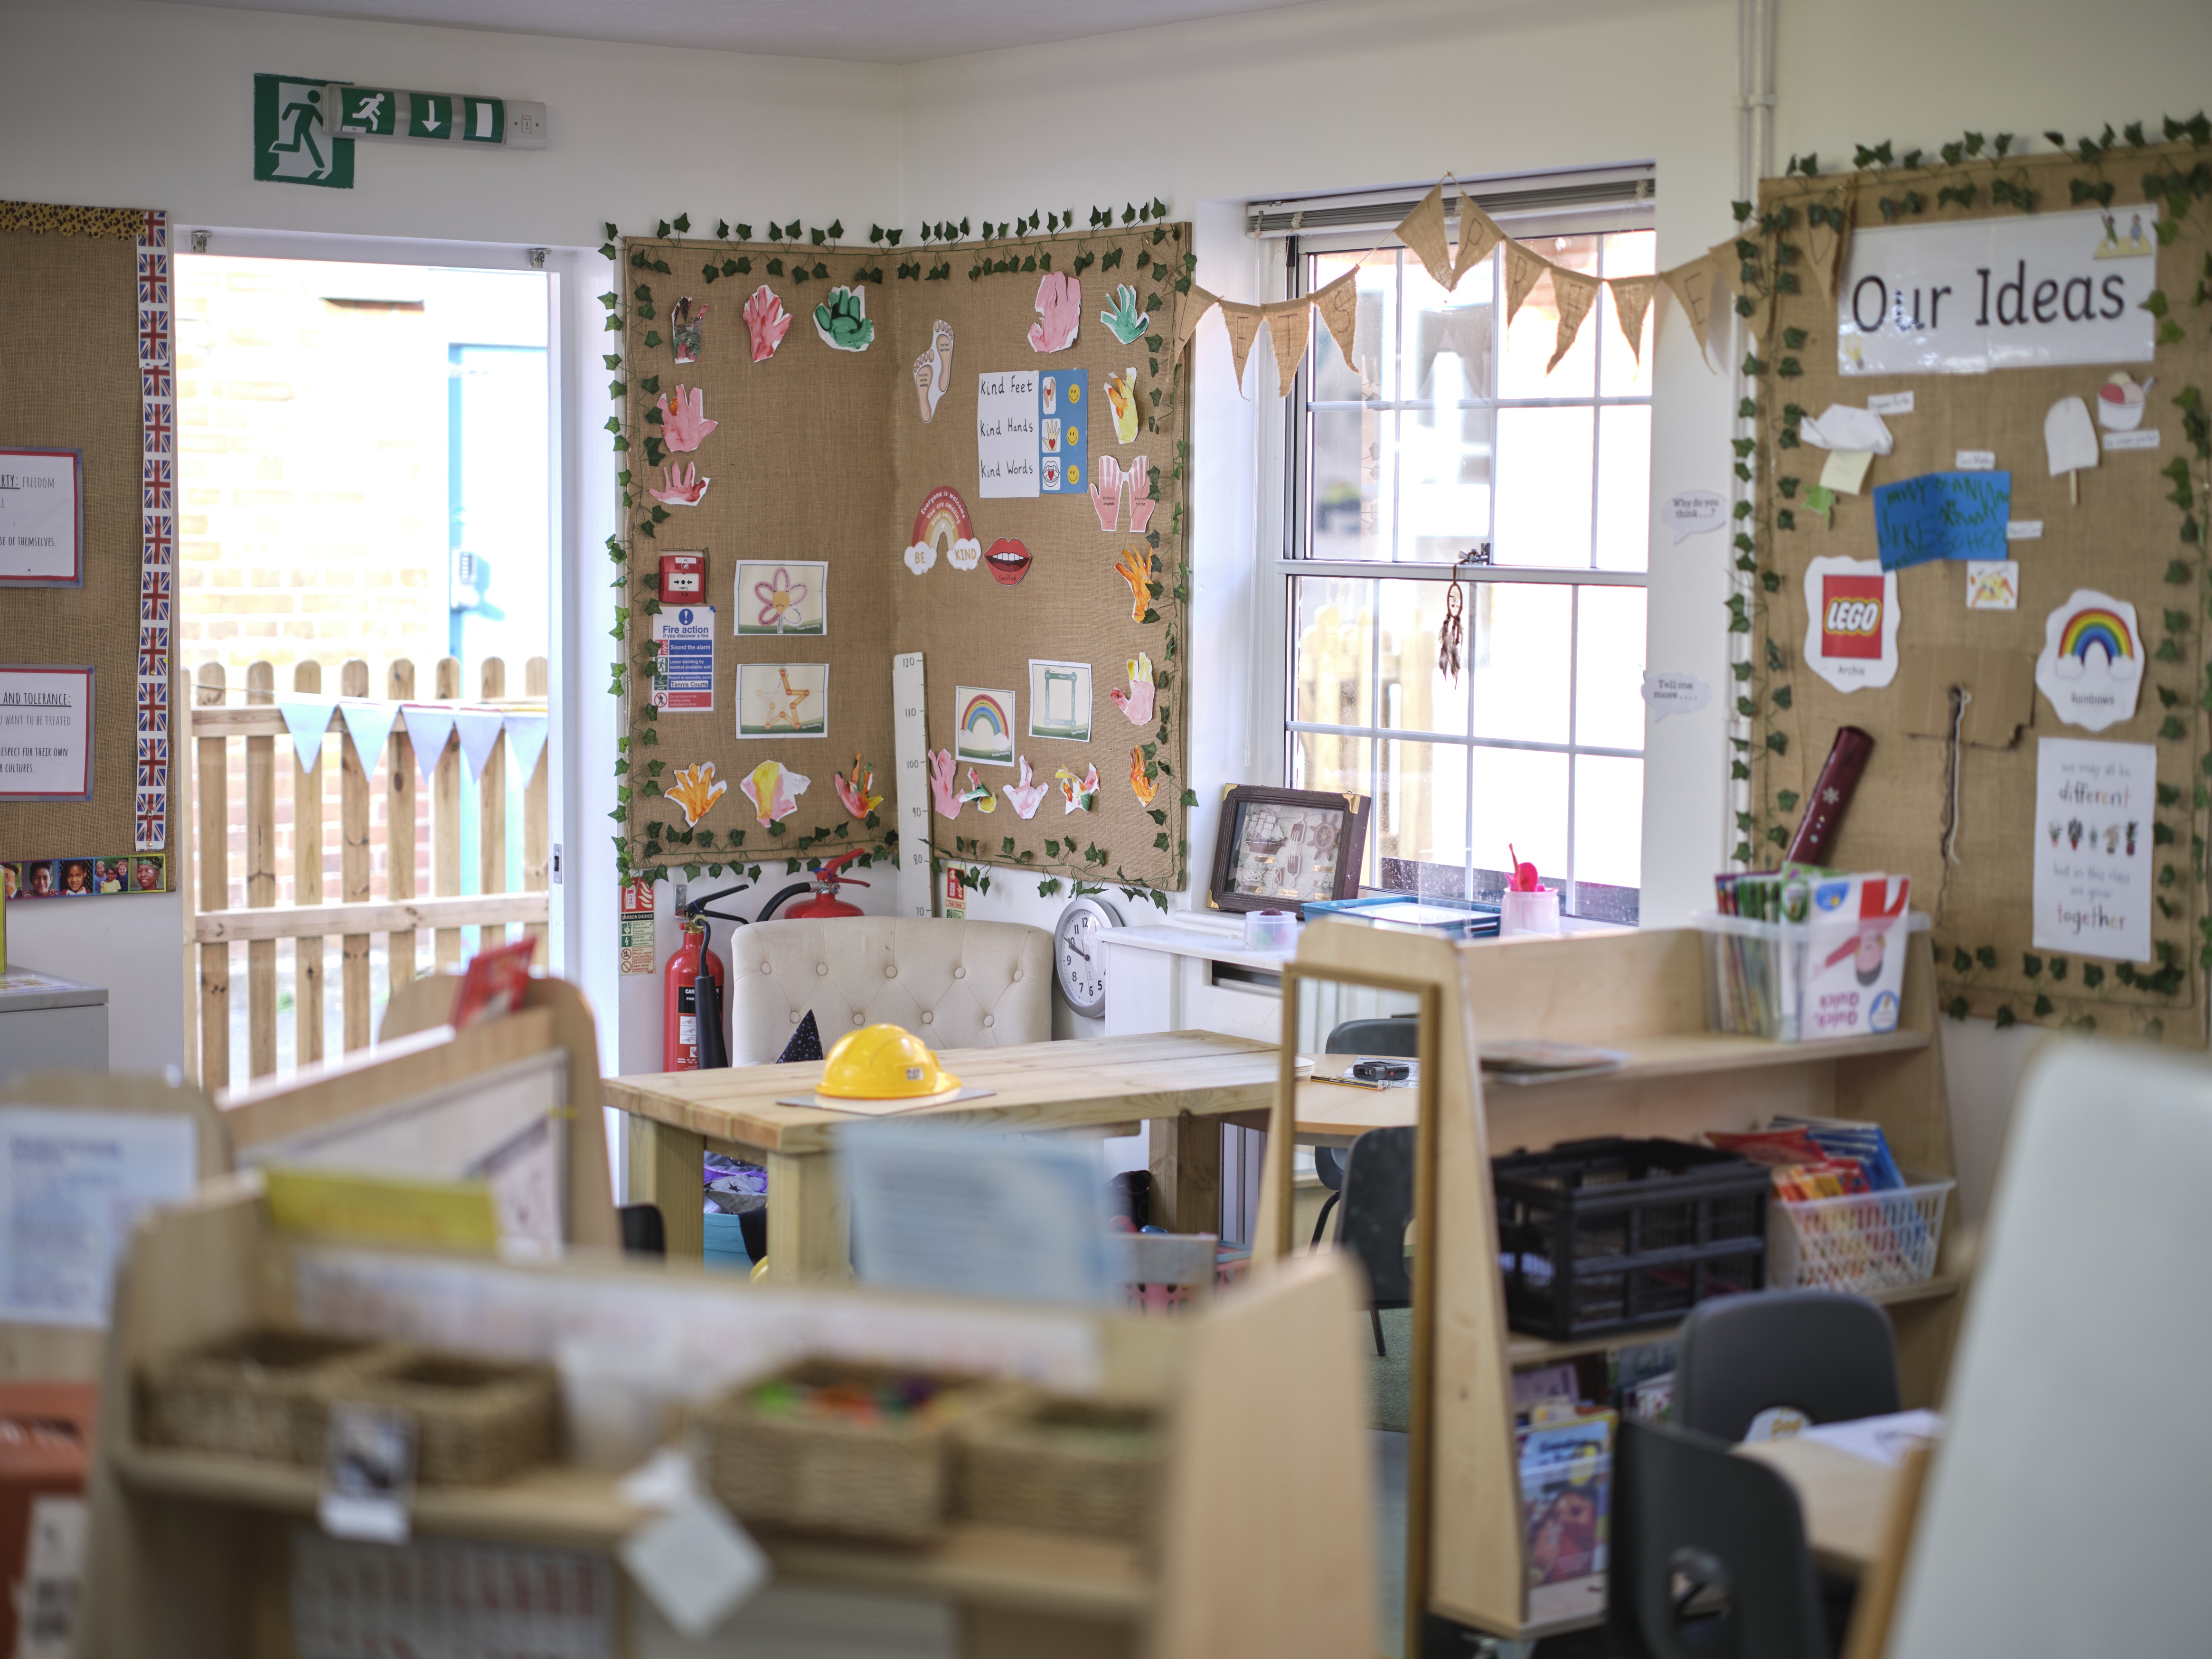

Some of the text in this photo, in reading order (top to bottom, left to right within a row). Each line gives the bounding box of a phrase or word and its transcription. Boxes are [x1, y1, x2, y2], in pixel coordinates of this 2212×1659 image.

[1853, 259, 2125, 332] Our Ideas
[981, 375, 1032, 395] Kind Feet
[980, 417, 1033, 437] Kind Hands
[1006, 459, 1033, 474] Words
[23, 477, 55, 489] FREEDOM
[921, 491, 942, 515] Everyone
[950, 493, 965, 519] welcome
[927, 509, 935, 518] You
[945, 503, 960, 524] amazing
[932, 512, 955, 529] Keep smiling
[8, 537, 16, 546] OF
[18, 537, 56, 547] THEMSELVES.
[915, 548, 977, 564] BE KIND
[1827, 602, 1878, 631] LEGO
[904, 657, 914, 667] 120
[1658, 680, 1675, 688] Tell
[3, 692, 71, 705] AND TOLERANCE:
[905, 708, 916, 717] 110
[5, 715, 71, 726] WANT TO BE TREATED
[23, 747, 33, 756] FOR
[36, 748, 51, 756] THEIR
[54, 748, 68, 756] OWN
[5, 764, 35, 773] CULTURES.
[907, 760, 919, 769] 100
[2059, 779, 2130, 808] different
[913, 807, 921, 818] 90
[913, 854, 922, 865] 80
[915, 907, 924, 916] 70
[1082, 917, 1088, 928] 12
[2058, 901, 2125, 934] together
[1074, 924, 1079, 934] 11
[1067, 955, 1071, 965] 9
[1072, 971, 1077, 981] 8
[1079, 982, 1083, 993] 7
[1098, 980, 1102, 990] 5
[1089, 986, 1093, 996] 6
